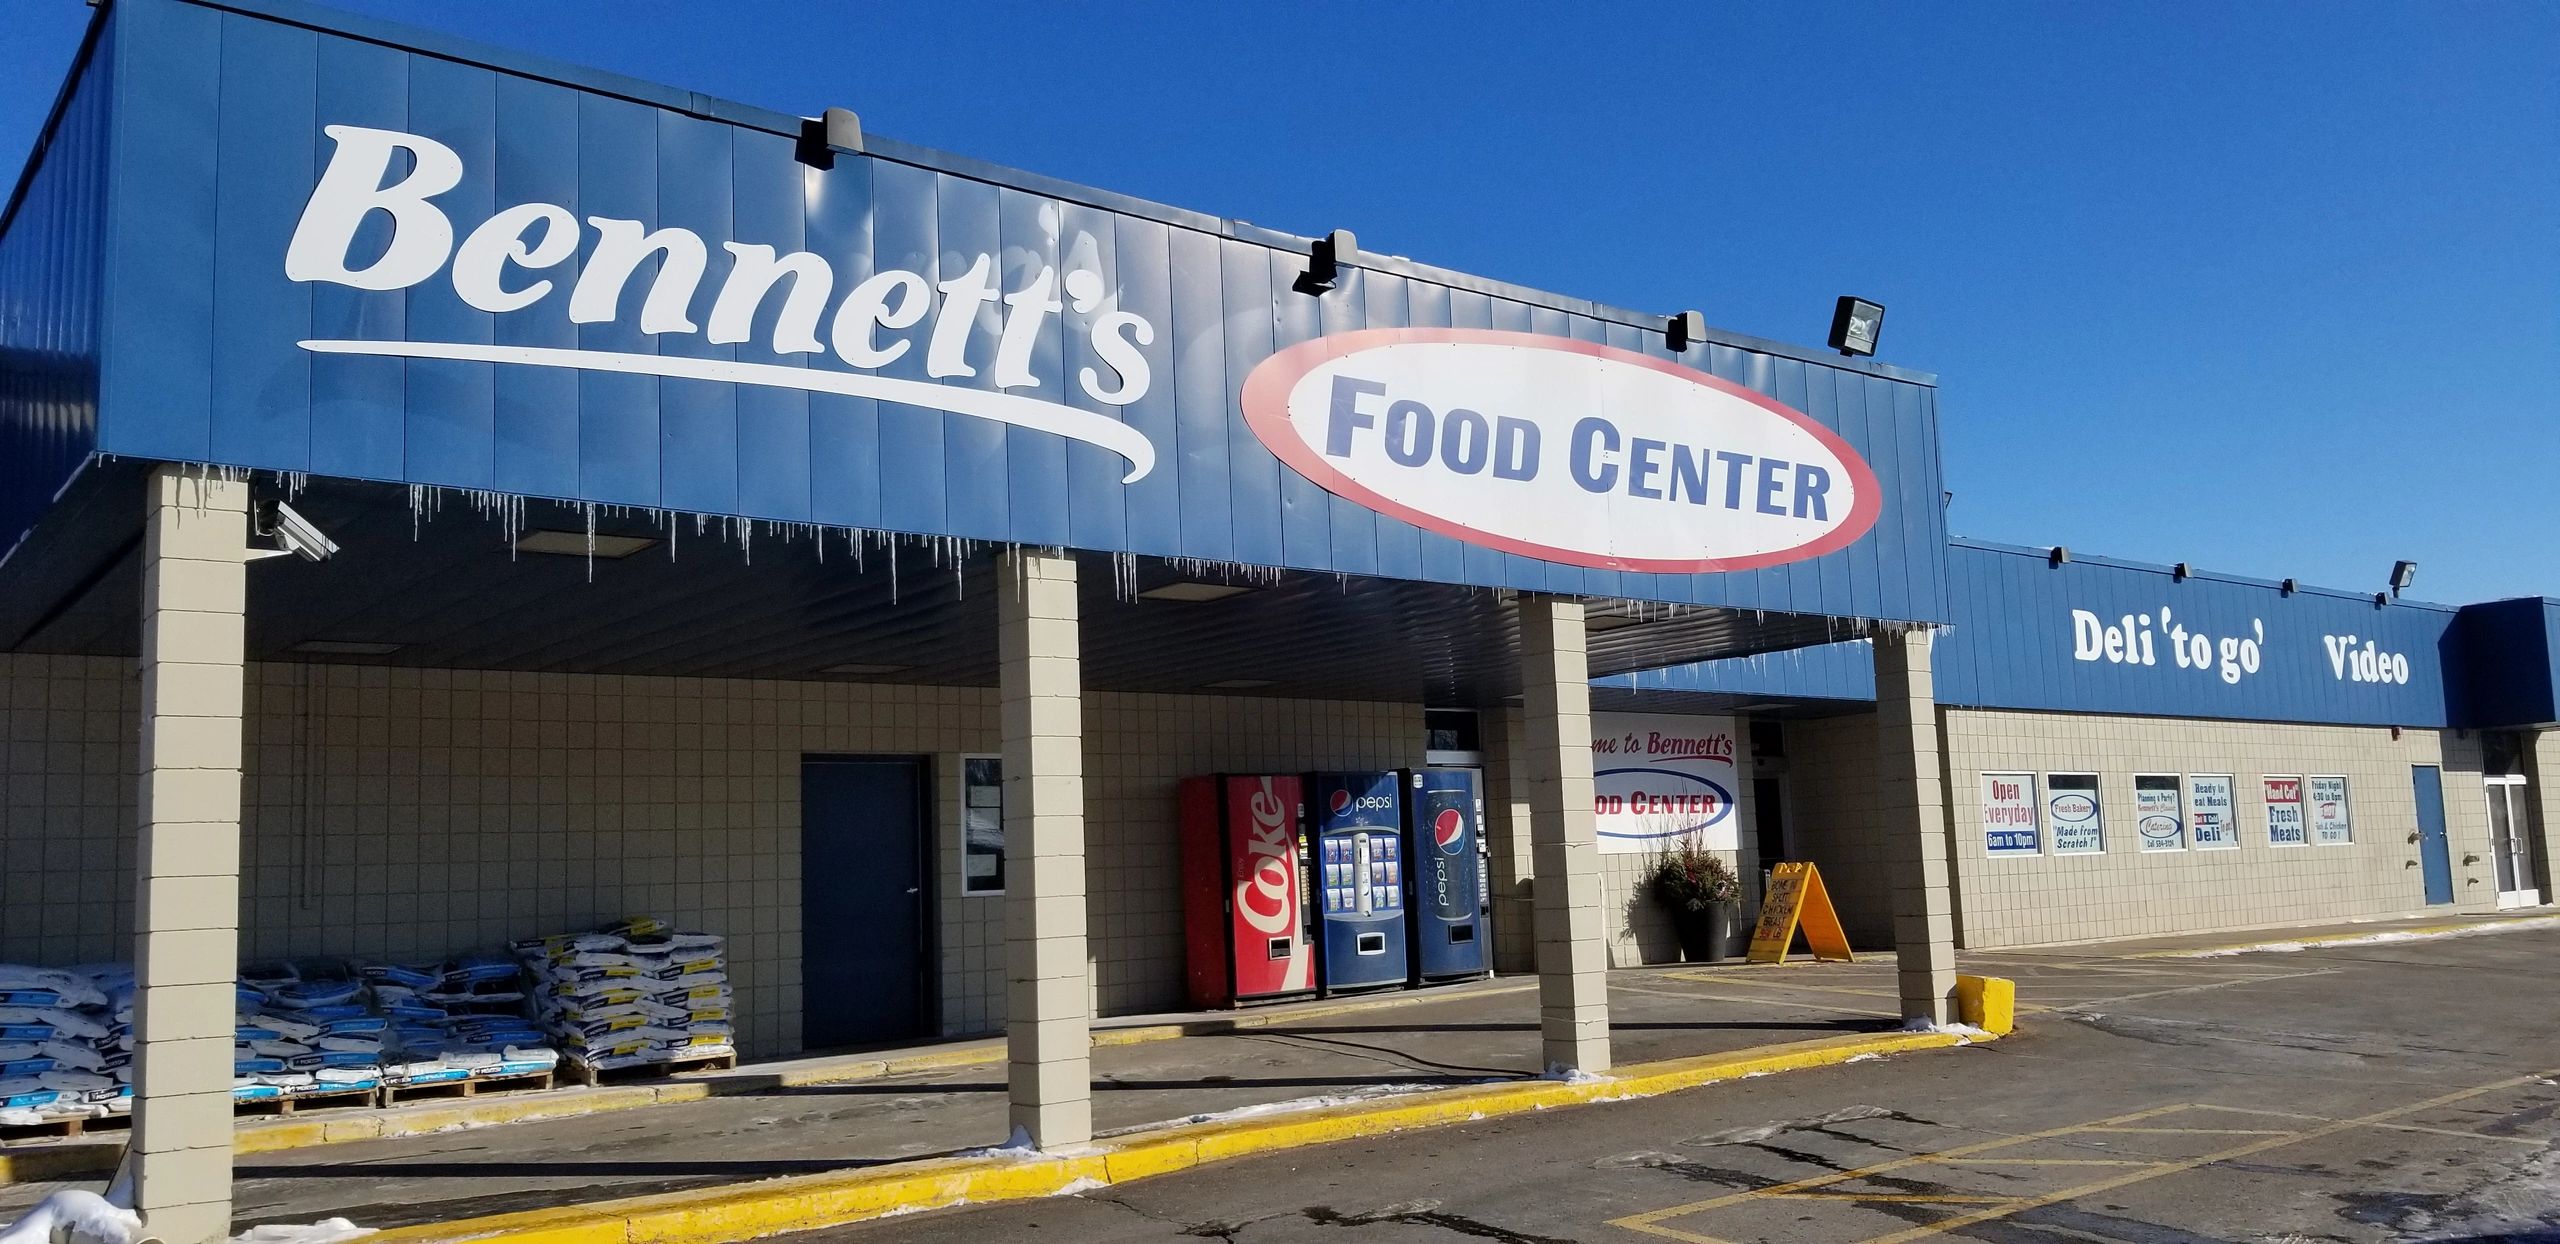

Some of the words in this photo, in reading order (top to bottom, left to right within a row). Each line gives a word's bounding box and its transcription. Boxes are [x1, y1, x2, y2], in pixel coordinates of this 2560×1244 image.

[285, 124, 1154, 406] Bennett's
[1325, 374, 1541, 482] FOOD
[1569, 416, 1831, 523] CENTER
[2072, 609, 2156, 667] Deli
[2324, 634, 2409, 685] Video
[1624, 732, 1642, 754] to
[1647, 731, 1733, 756] Bennett's
[1992, 780, 2020, 802] Open
[2195, 783, 2216, 796] Ready
[2311, 780, 2327, 792] Friday
[1355, 793, 1393, 812] pepsi
[1594, 795, 1623, 816] OD
[1630, 791, 1716, 815] CENTER
[2054, 804, 2071, 813] Fresh
[2072, 803, 2091, 813] Bakery
[2194, 797, 2205, 807] eat
[2206, 796, 2228, 807] Meals
[1984, 803, 2034, 826] Everyday
[2268, 805, 2299, 823] Fresh
[2079, 825, 2098, 836] from
[2145, 818, 2173, 834] Catering
[2195, 826, 2222, 842] Deli
[2270, 825, 2301, 842] Meats
[1988, 833, 2004, 847] 6am
[2005, 833, 2013, 846] to
[2014, 832, 2034, 849] 10pm
[1237, 776, 1290, 934] Coke
[1434, 857, 1449, 906] pepsi
